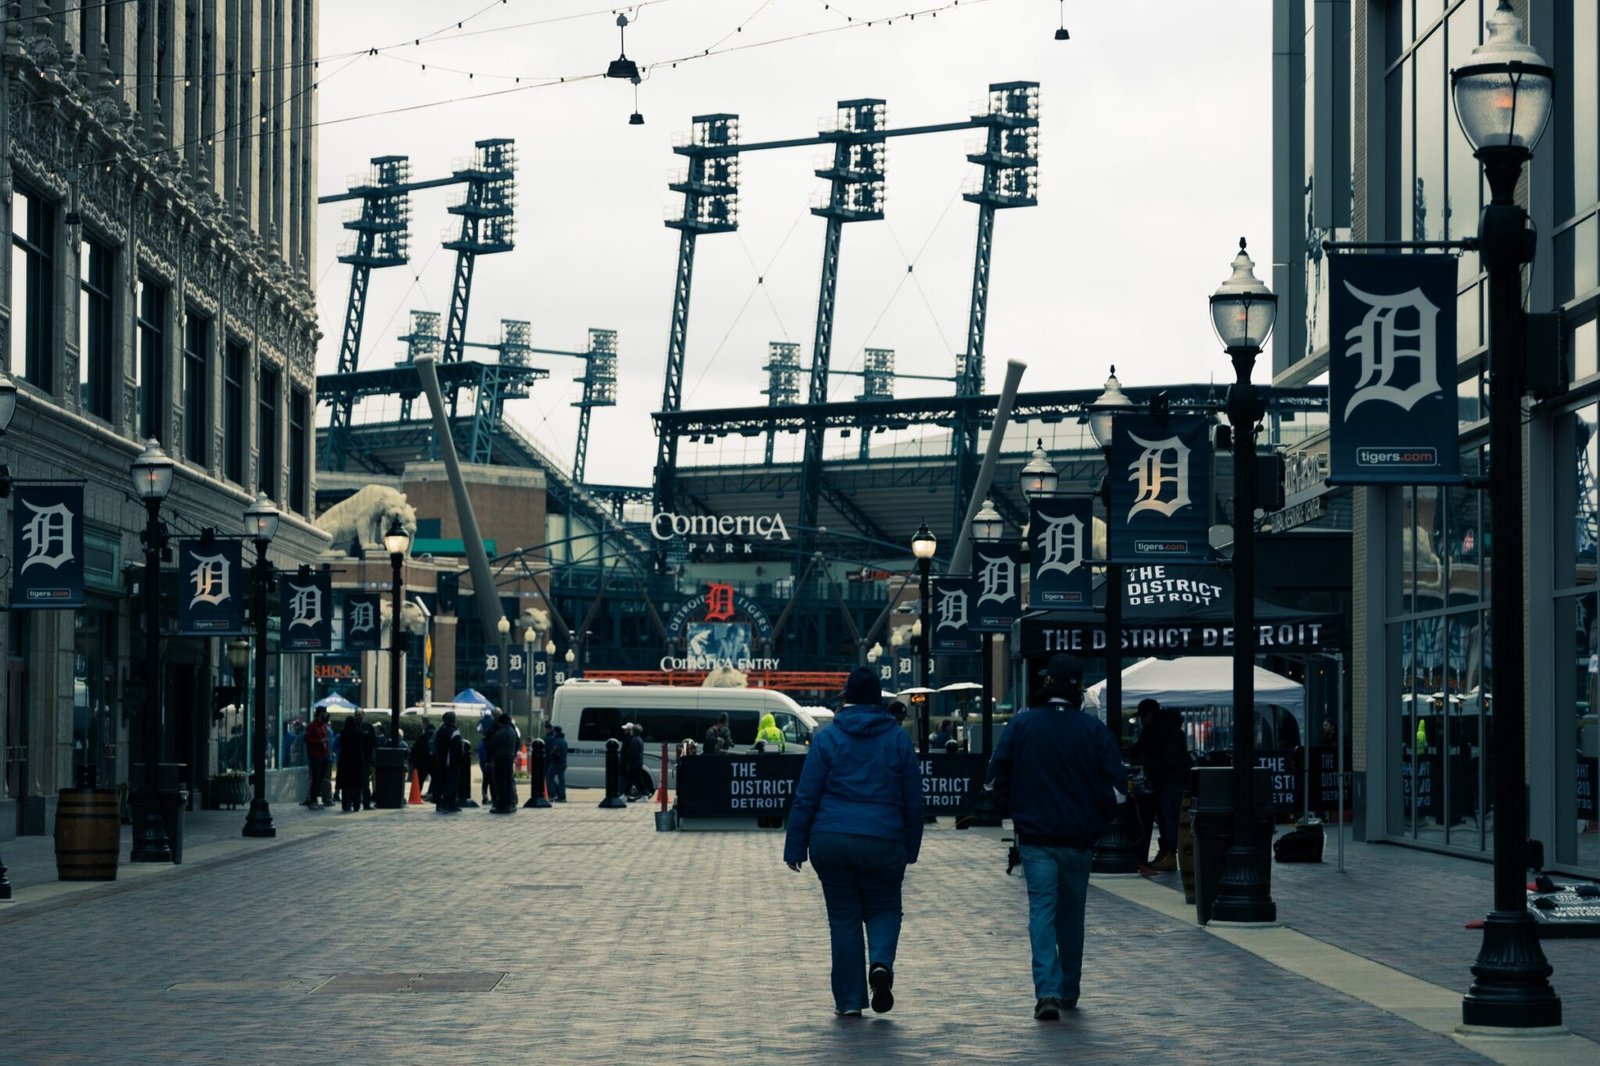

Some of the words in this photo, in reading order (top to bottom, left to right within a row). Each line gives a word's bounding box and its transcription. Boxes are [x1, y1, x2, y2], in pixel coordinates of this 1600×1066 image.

[1343, 279, 1443, 423] D
[1361, 451, 1433, 464] tigers.com
[1126, 429, 1192, 525] D
[20, 498, 75, 575] D
[688, 543, 752, 553] PARK
[1036, 509, 1085, 581] D
[1137, 542, 1185, 552] tigers.com
[188, 550, 231, 611] D
[977, 551, 1016, 608] D
[1126, 565, 1165, 582] THE
[29, 590, 69, 598] tigers.com
[1127, 579, 1222, 599] DISTRICT
[288, 582, 323, 631] D
[703, 580, 735, 622] D
[1129, 593, 1212, 606] DETROIT
[349, 599, 375, 635] D
[669, 594, 706, 632] DETROIT
[737, 596, 770, 633] TIGERS
[936, 585, 968, 633] D
[1043, 629, 1082, 651] THE
[1093, 627, 1192, 650] DSTRICT
[1202, 624, 1323, 647] DEROIT
[737, 658, 780, 670] ENTRY
[730, 762, 757, 777] THE
[917, 760, 933, 775] HE
[1258, 757, 1285, 772] THE
[1321, 754, 1334, 769] THE
[730, 779, 794, 795] DISTRICT
[921, 777, 970, 793] STRICT
[1321, 771, 1352, 787] DISTCT
[730, 797, 786, 809] DETROIT
[924, 794, 961, 806] TROIT
